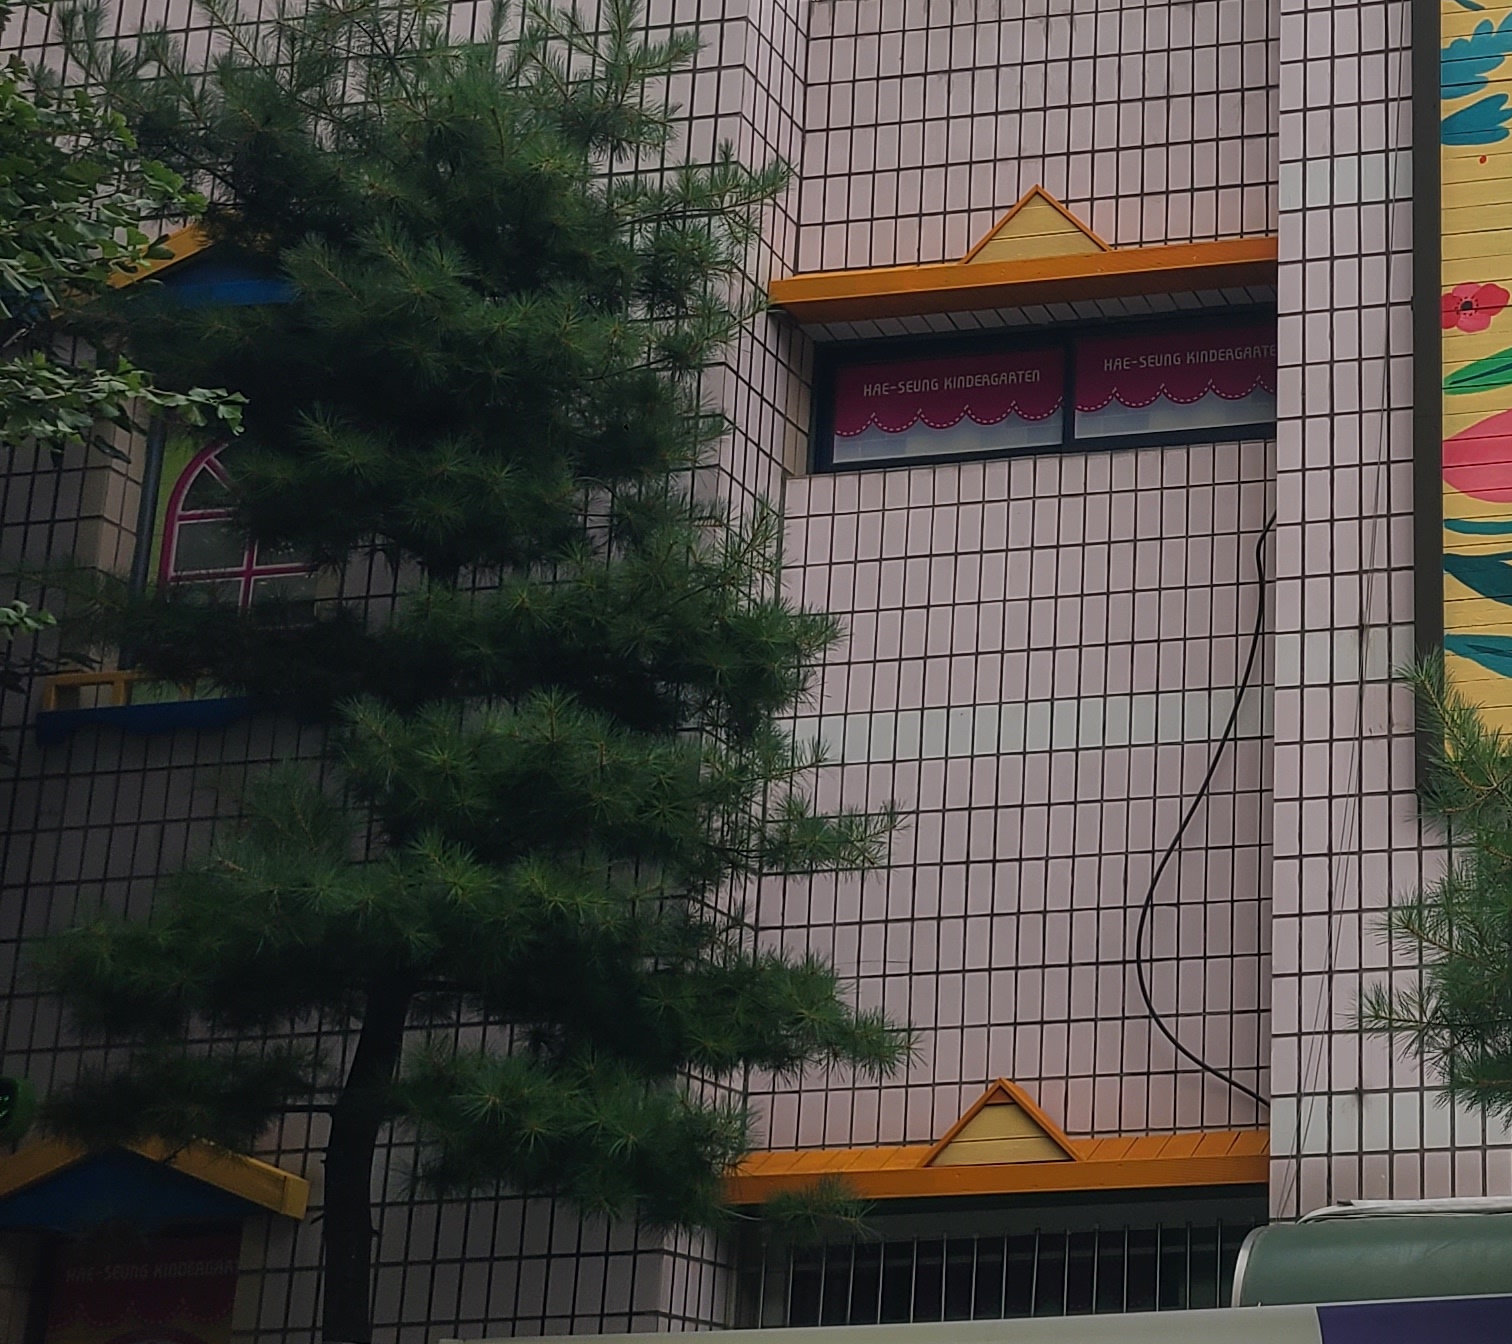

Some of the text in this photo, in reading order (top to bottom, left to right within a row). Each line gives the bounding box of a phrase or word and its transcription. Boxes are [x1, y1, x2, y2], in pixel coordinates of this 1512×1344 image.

[1103, 352, 1181, 372] HAE-SEUNG
[863, 369, 1041, 397] HAE-SEUNG KINDERGARTEN
